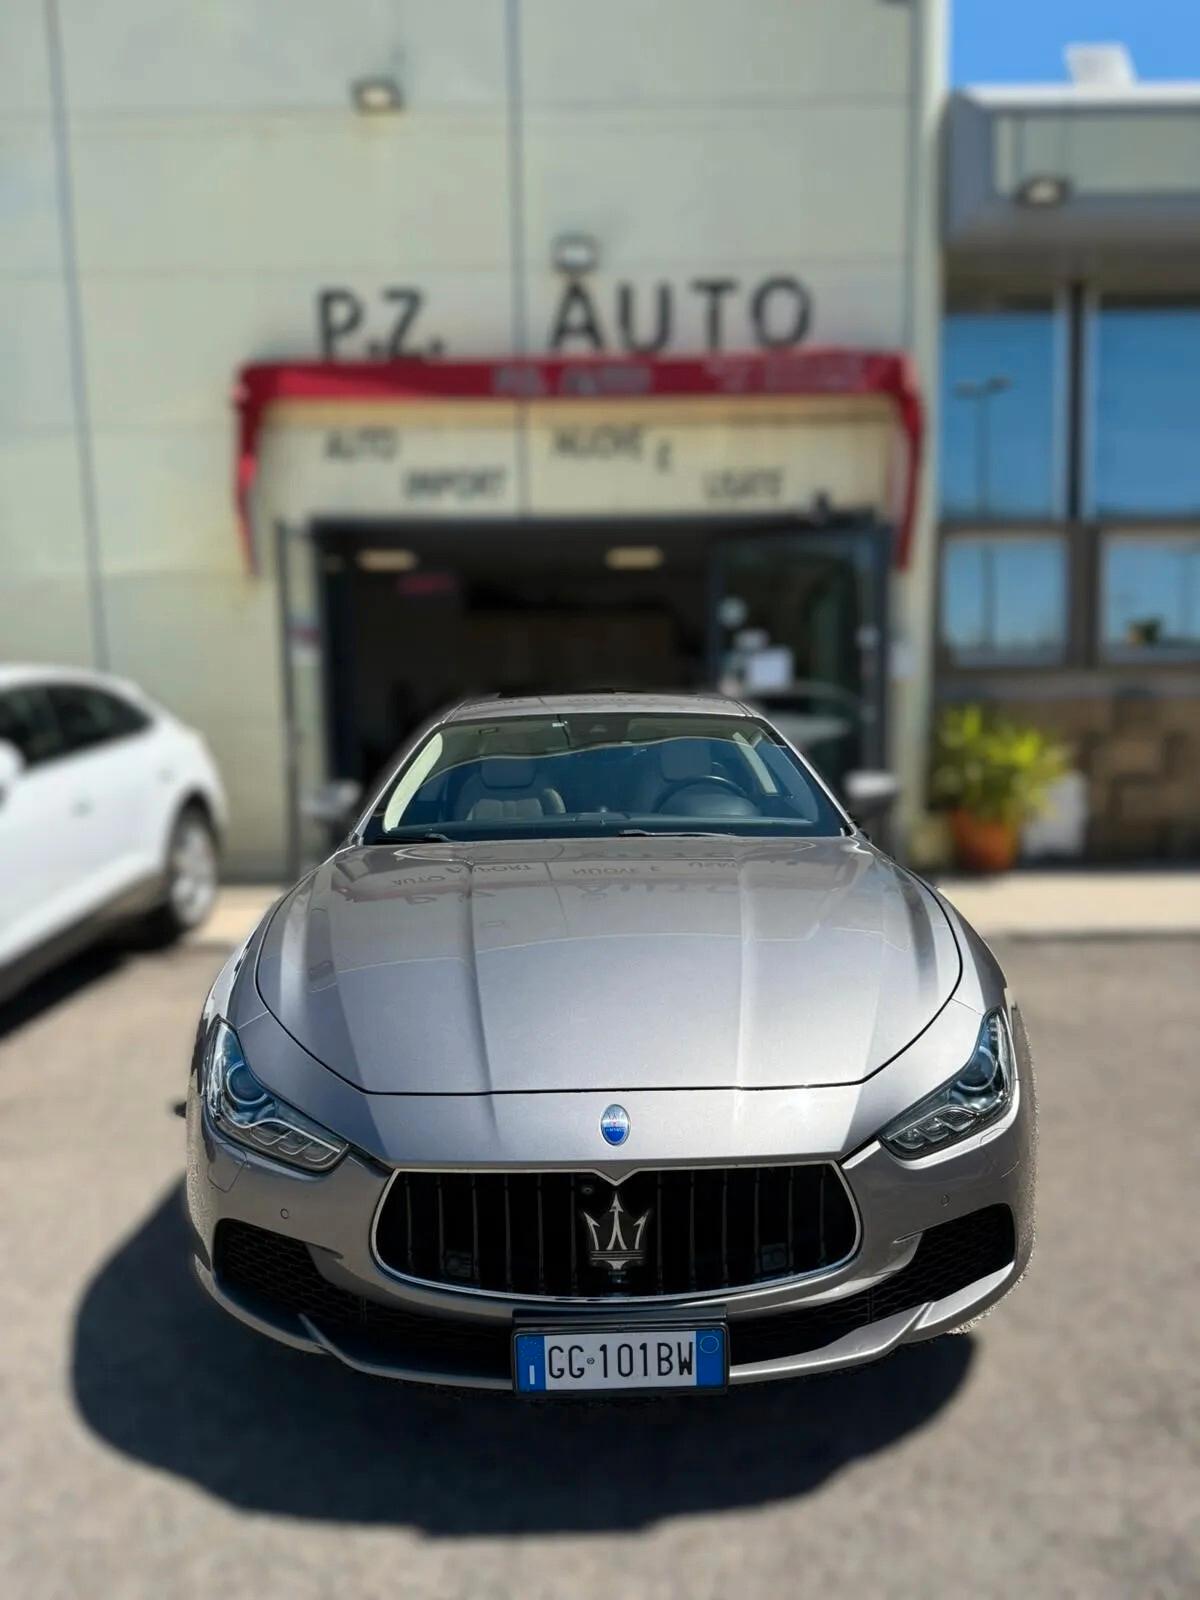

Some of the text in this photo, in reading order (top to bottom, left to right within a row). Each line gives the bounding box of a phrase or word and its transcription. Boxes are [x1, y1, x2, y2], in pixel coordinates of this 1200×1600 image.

[316, 276, 814, 361] P.Z. AUTO
[324, 428, 395, 460] AUTO
